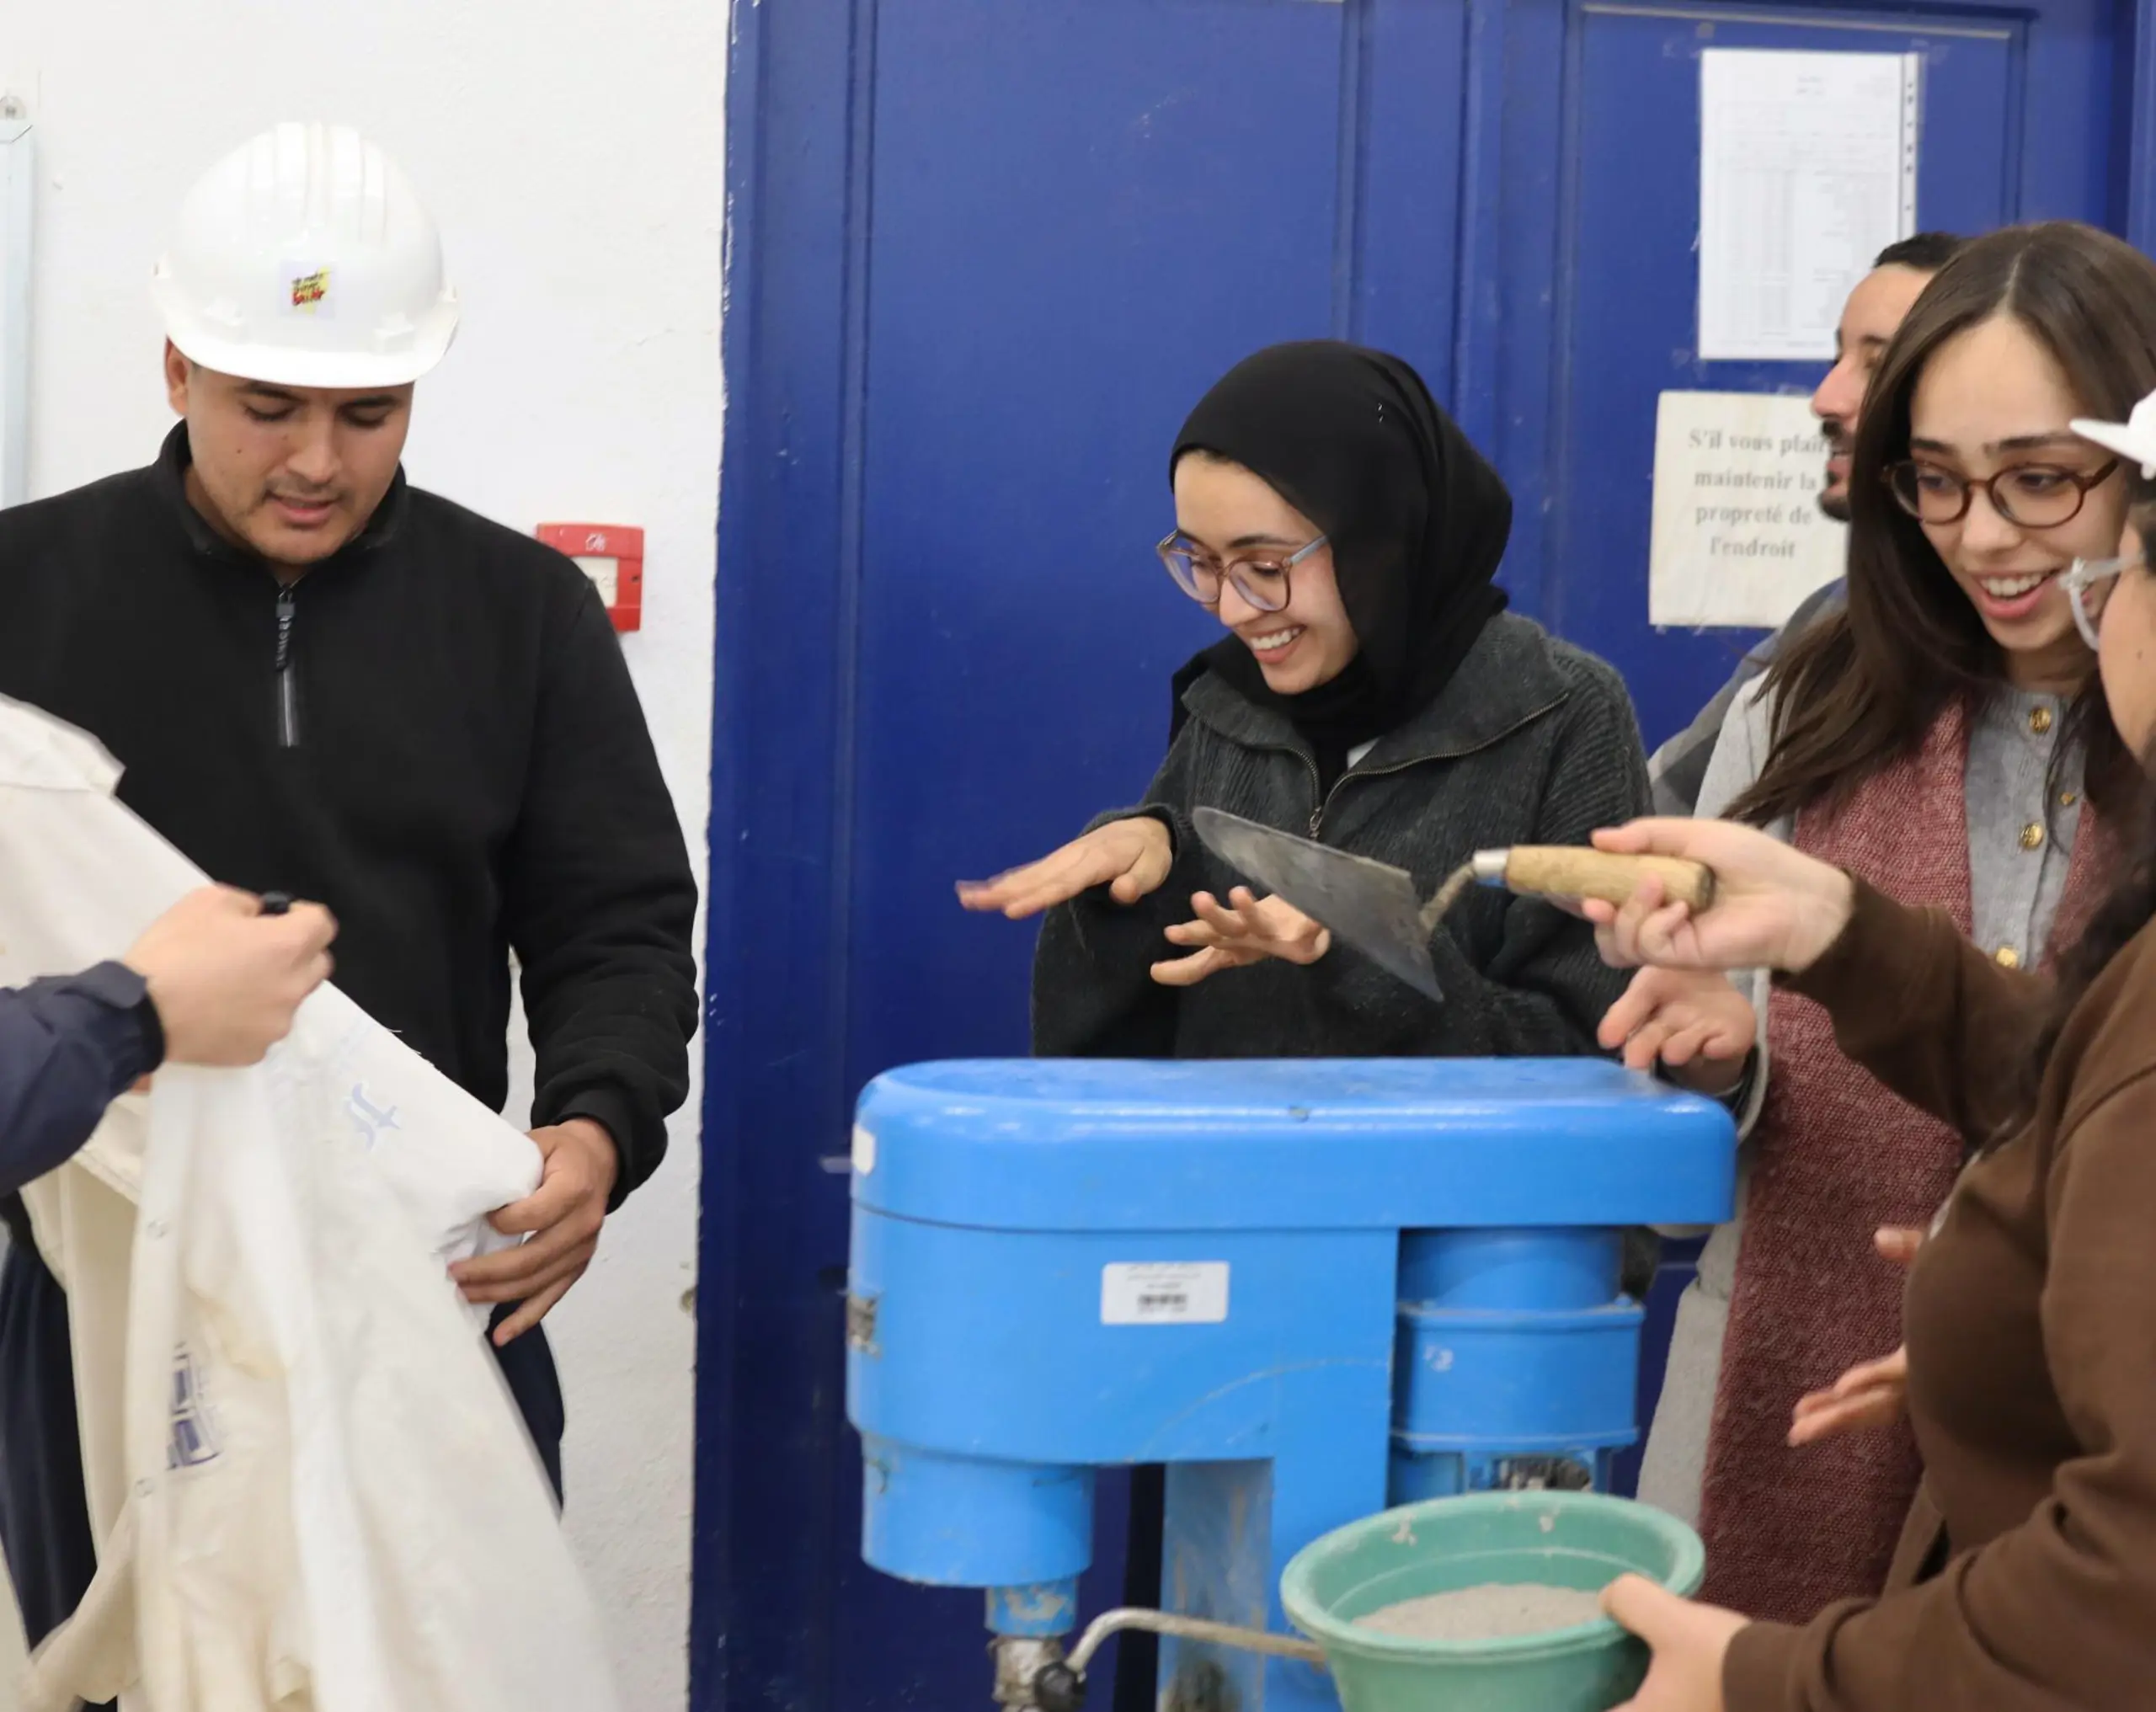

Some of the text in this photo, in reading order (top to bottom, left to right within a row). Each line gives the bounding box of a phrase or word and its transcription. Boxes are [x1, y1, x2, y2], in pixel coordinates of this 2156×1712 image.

[1729, 436, 1773, 452] vous
[1694, 469, 1817, 490] maintenir la
[1694, 505, 1812, 528] propreté de
[1710, 536, 1796, 558] l'endroit
